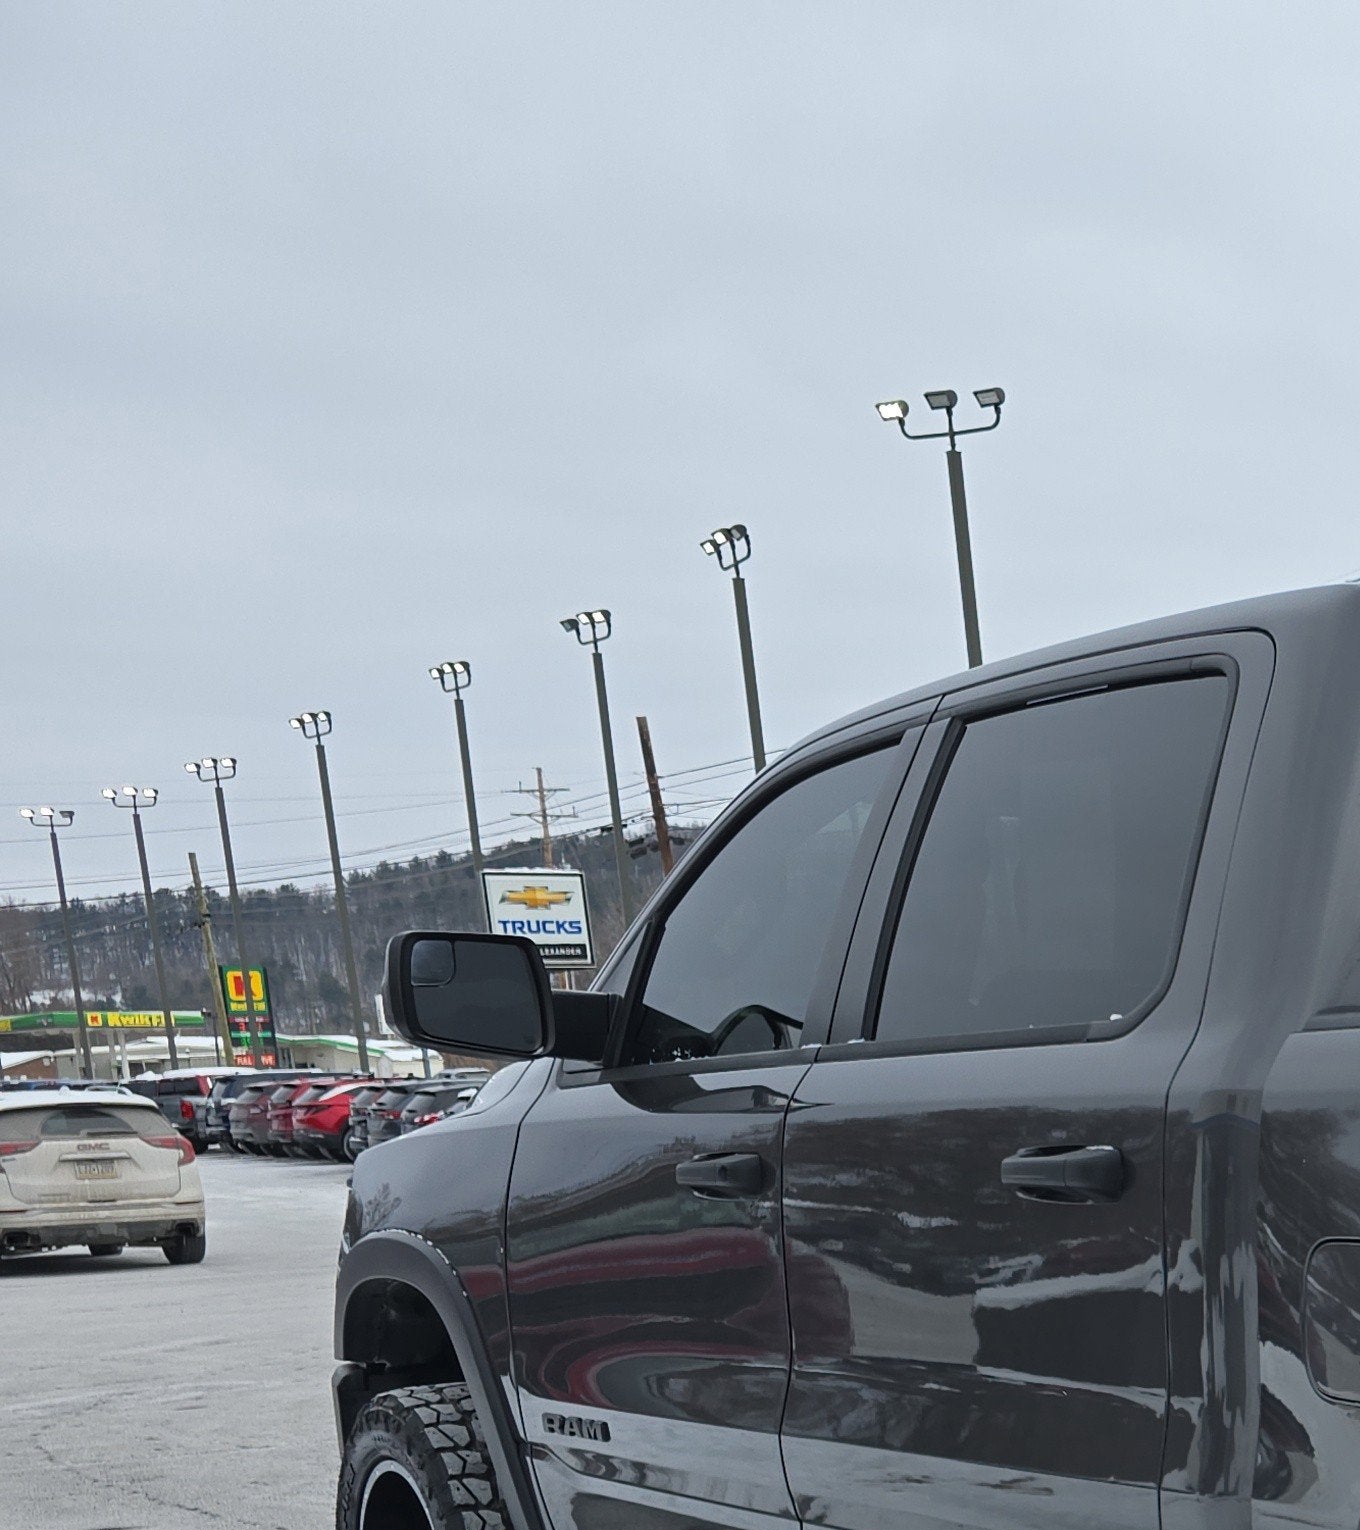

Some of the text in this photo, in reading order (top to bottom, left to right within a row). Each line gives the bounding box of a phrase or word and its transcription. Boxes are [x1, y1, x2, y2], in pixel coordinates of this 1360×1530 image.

[498, 920, 582, 934] TRUCKS
[77, 1143, 110, 1151] GMC
[541, 1412, 611, 1442] RAM
